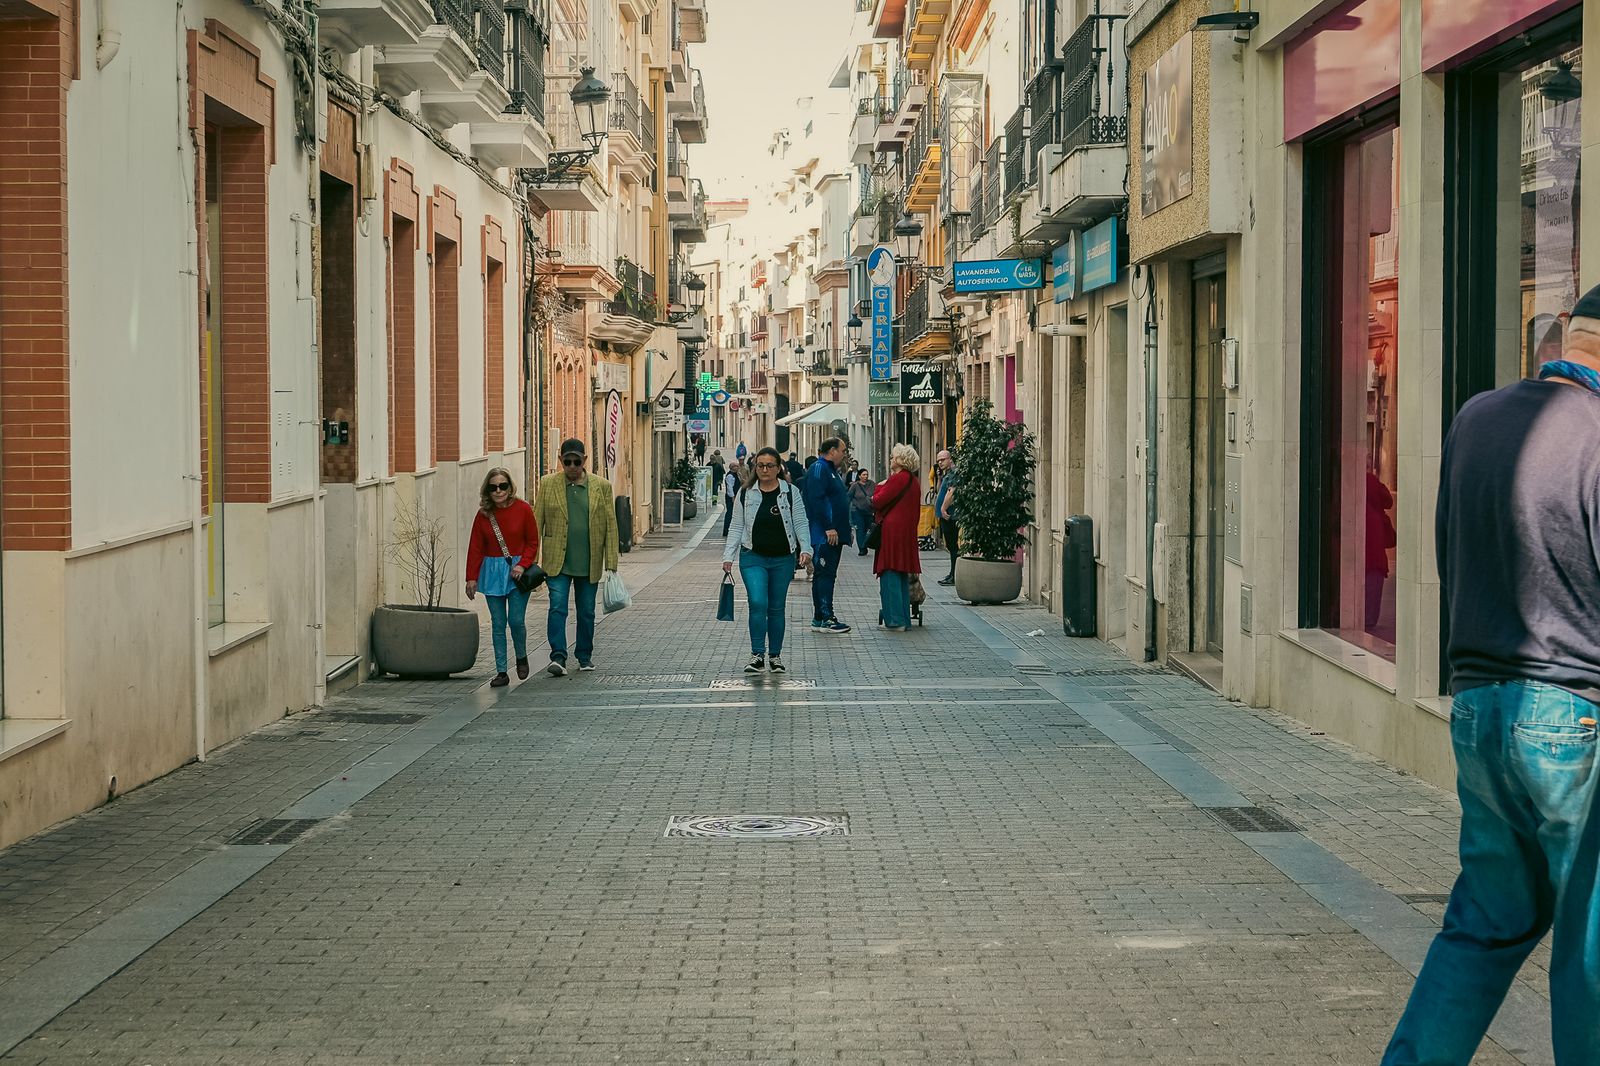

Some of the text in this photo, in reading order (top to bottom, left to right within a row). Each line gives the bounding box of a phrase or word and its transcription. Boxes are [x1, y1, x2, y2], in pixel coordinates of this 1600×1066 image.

[956, 266, 1001, 277] LAVANDERÍA
[956, 277, 1009, 287] AUTOSERVICIO
[874, 289, 889, 378] GIRLADY
[908, 390, 935, 400] JUSTO
